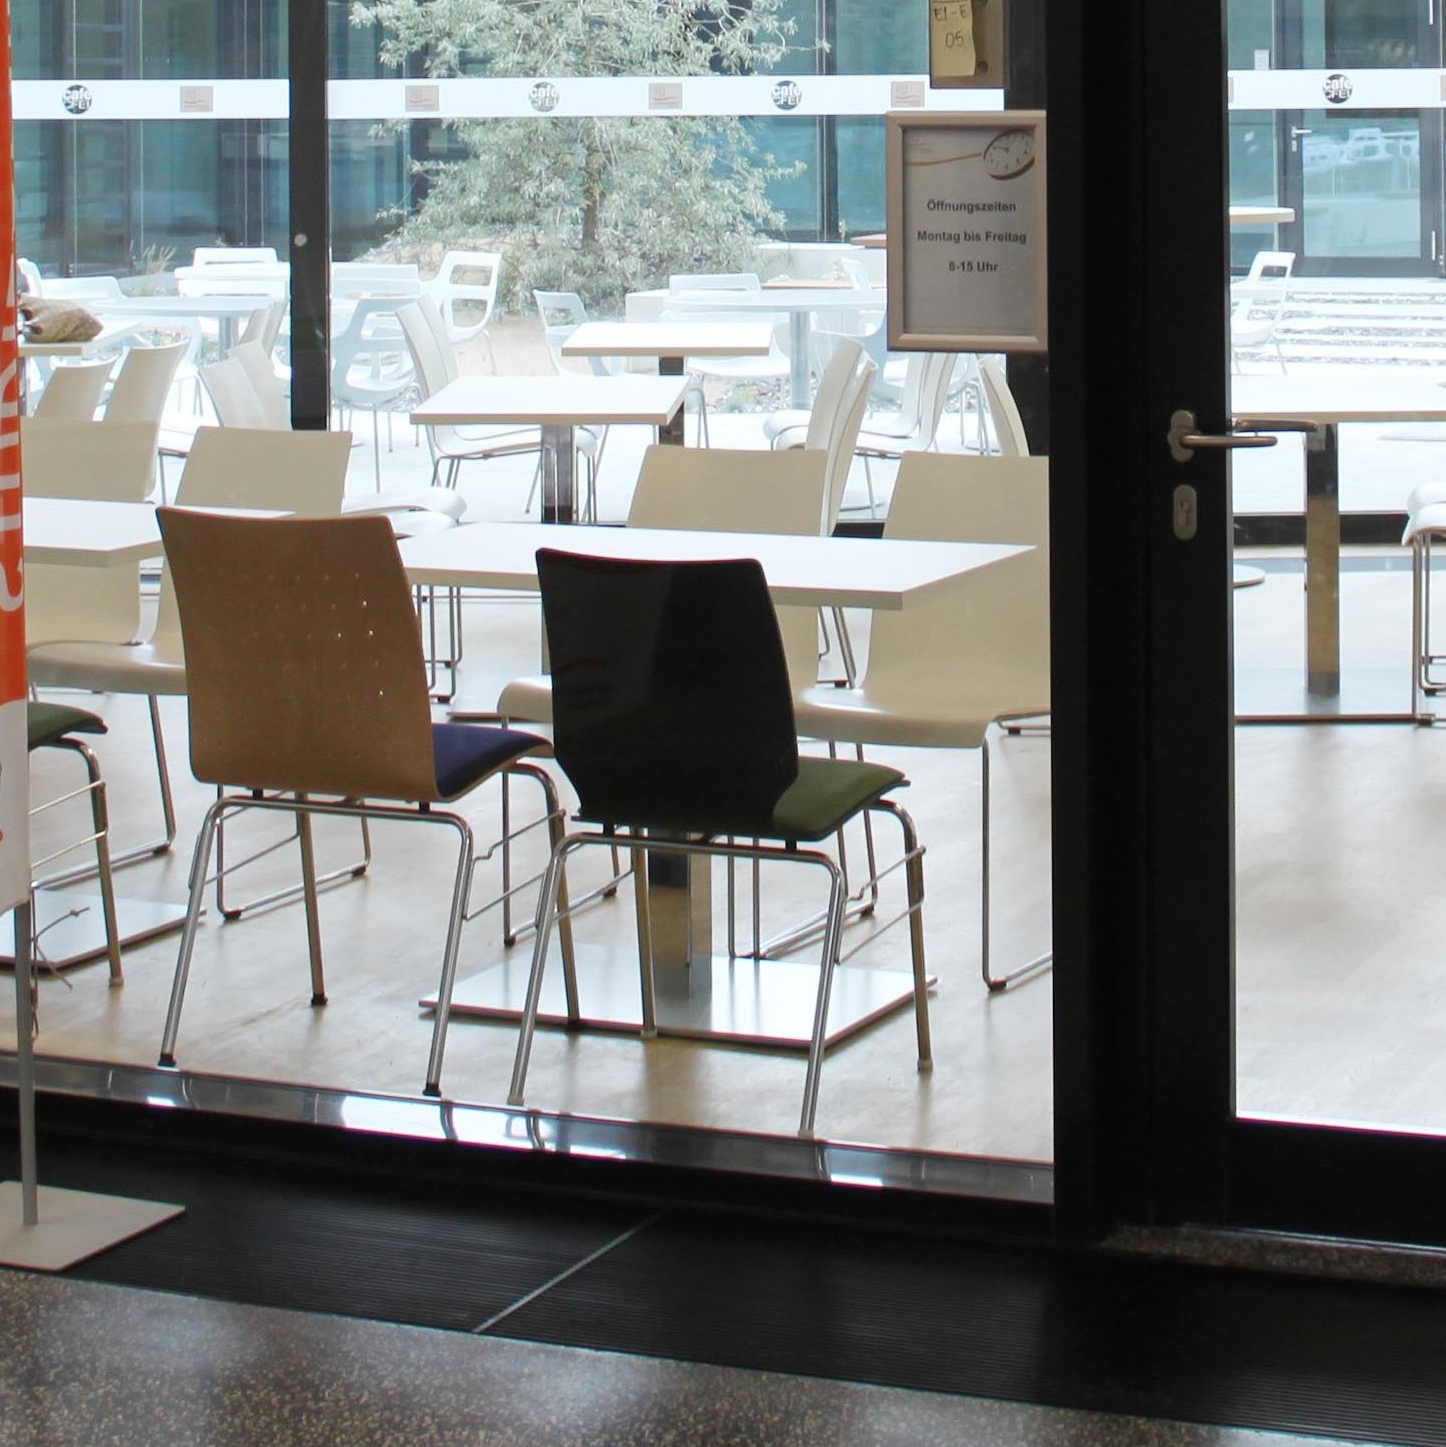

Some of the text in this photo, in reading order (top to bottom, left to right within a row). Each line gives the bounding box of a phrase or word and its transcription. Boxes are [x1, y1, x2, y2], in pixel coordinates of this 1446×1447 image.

[926, 198, 1017, 215] Öffnungszeiten
[917, 230, 1027, 245] Montag bis Freitag
[977, 260, 999, 273] Uhr
